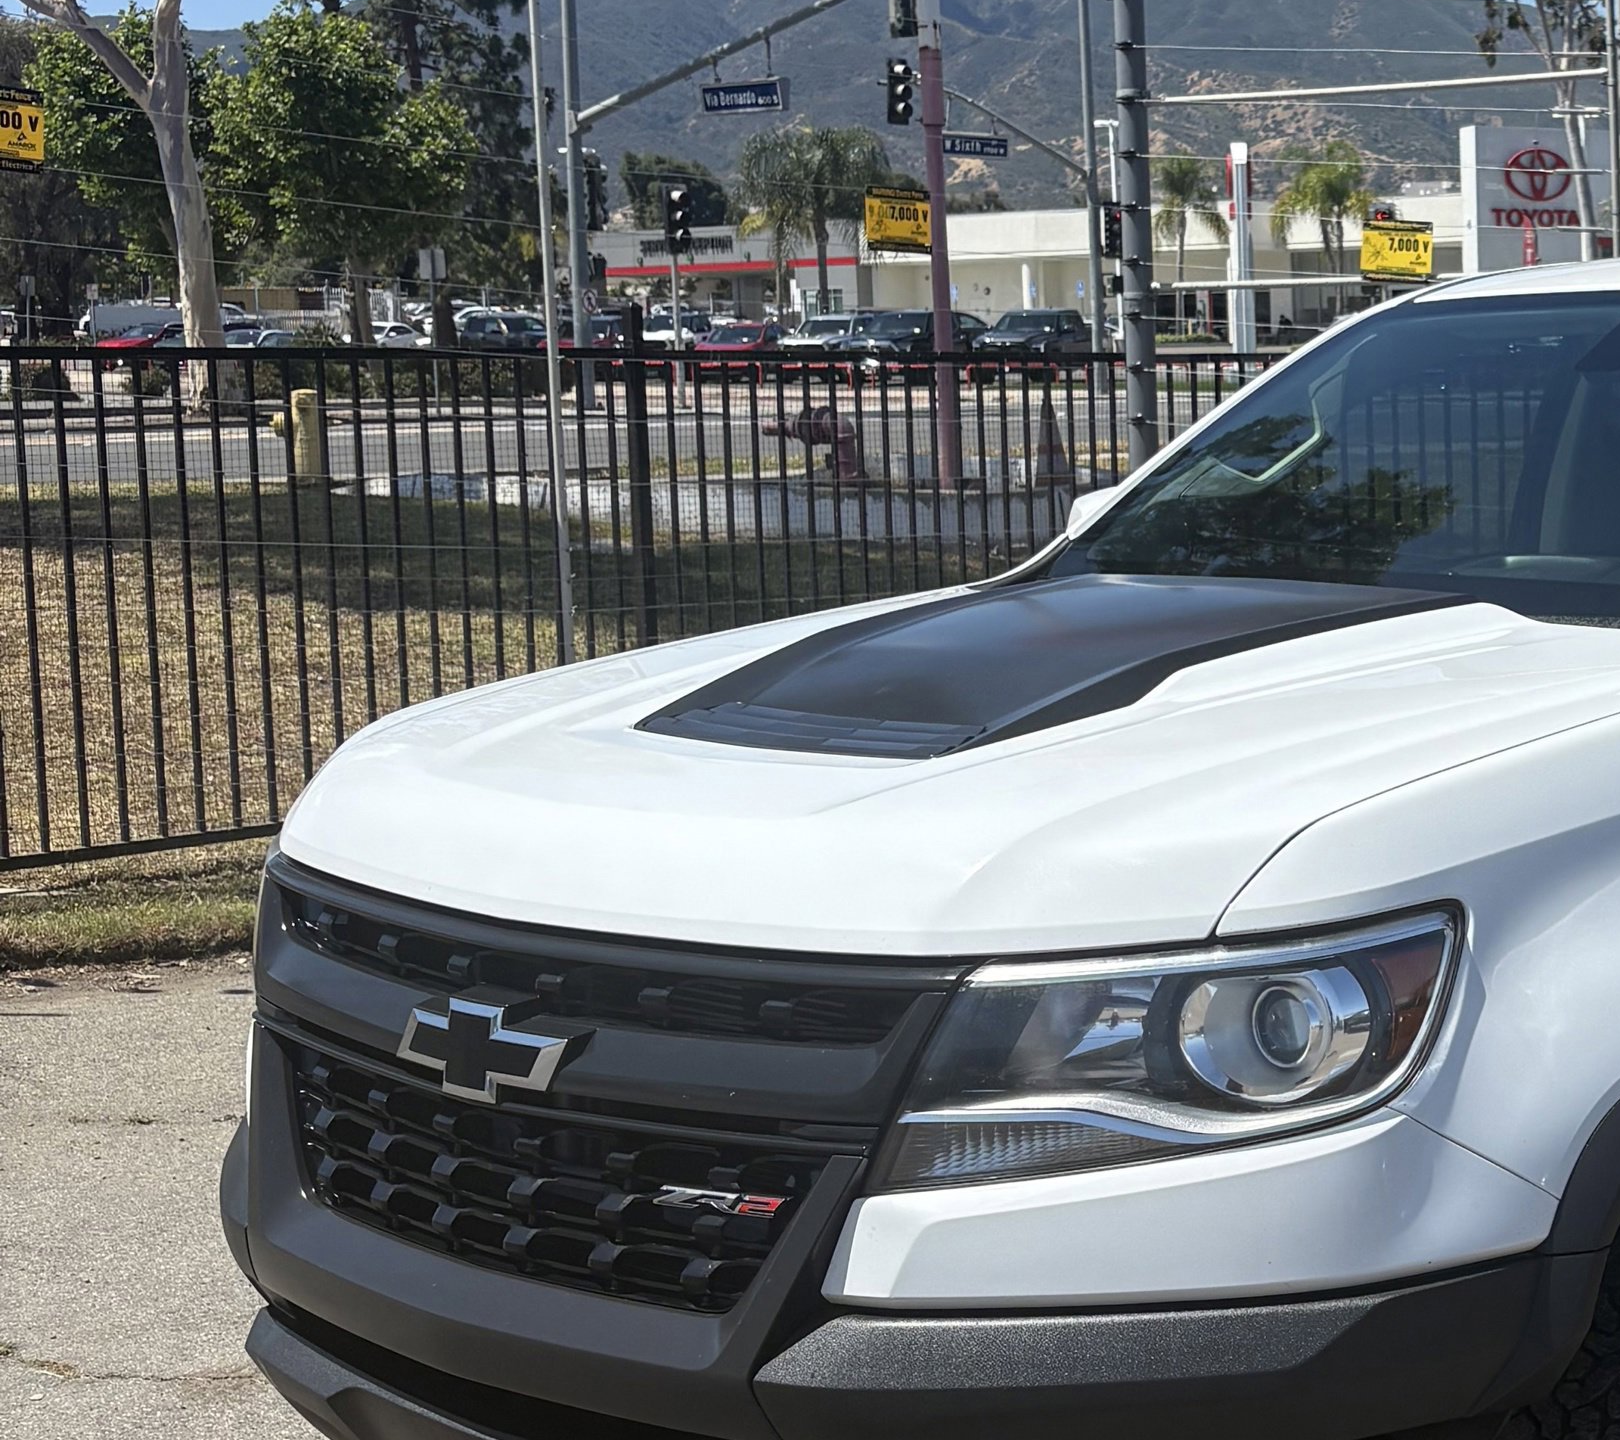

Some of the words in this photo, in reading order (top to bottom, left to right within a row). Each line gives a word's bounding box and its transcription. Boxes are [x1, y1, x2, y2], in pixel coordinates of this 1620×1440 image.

[704, 92, 719, 107] Via
[719, 89, 756, 106] Bernardo
[28, 115, 39, 133] V
[954, 138, 982, 153] Sixth
[889, 205, 919, 222] 7,000
[922, 209, 928, 223] V
[1491, 208, 1581, 227] TOYOTA
[1388, 238, 1420, 253] 7,000
[1422, 240, 1430, 254] V
[652, 1184, 787, 1219] ZR2
